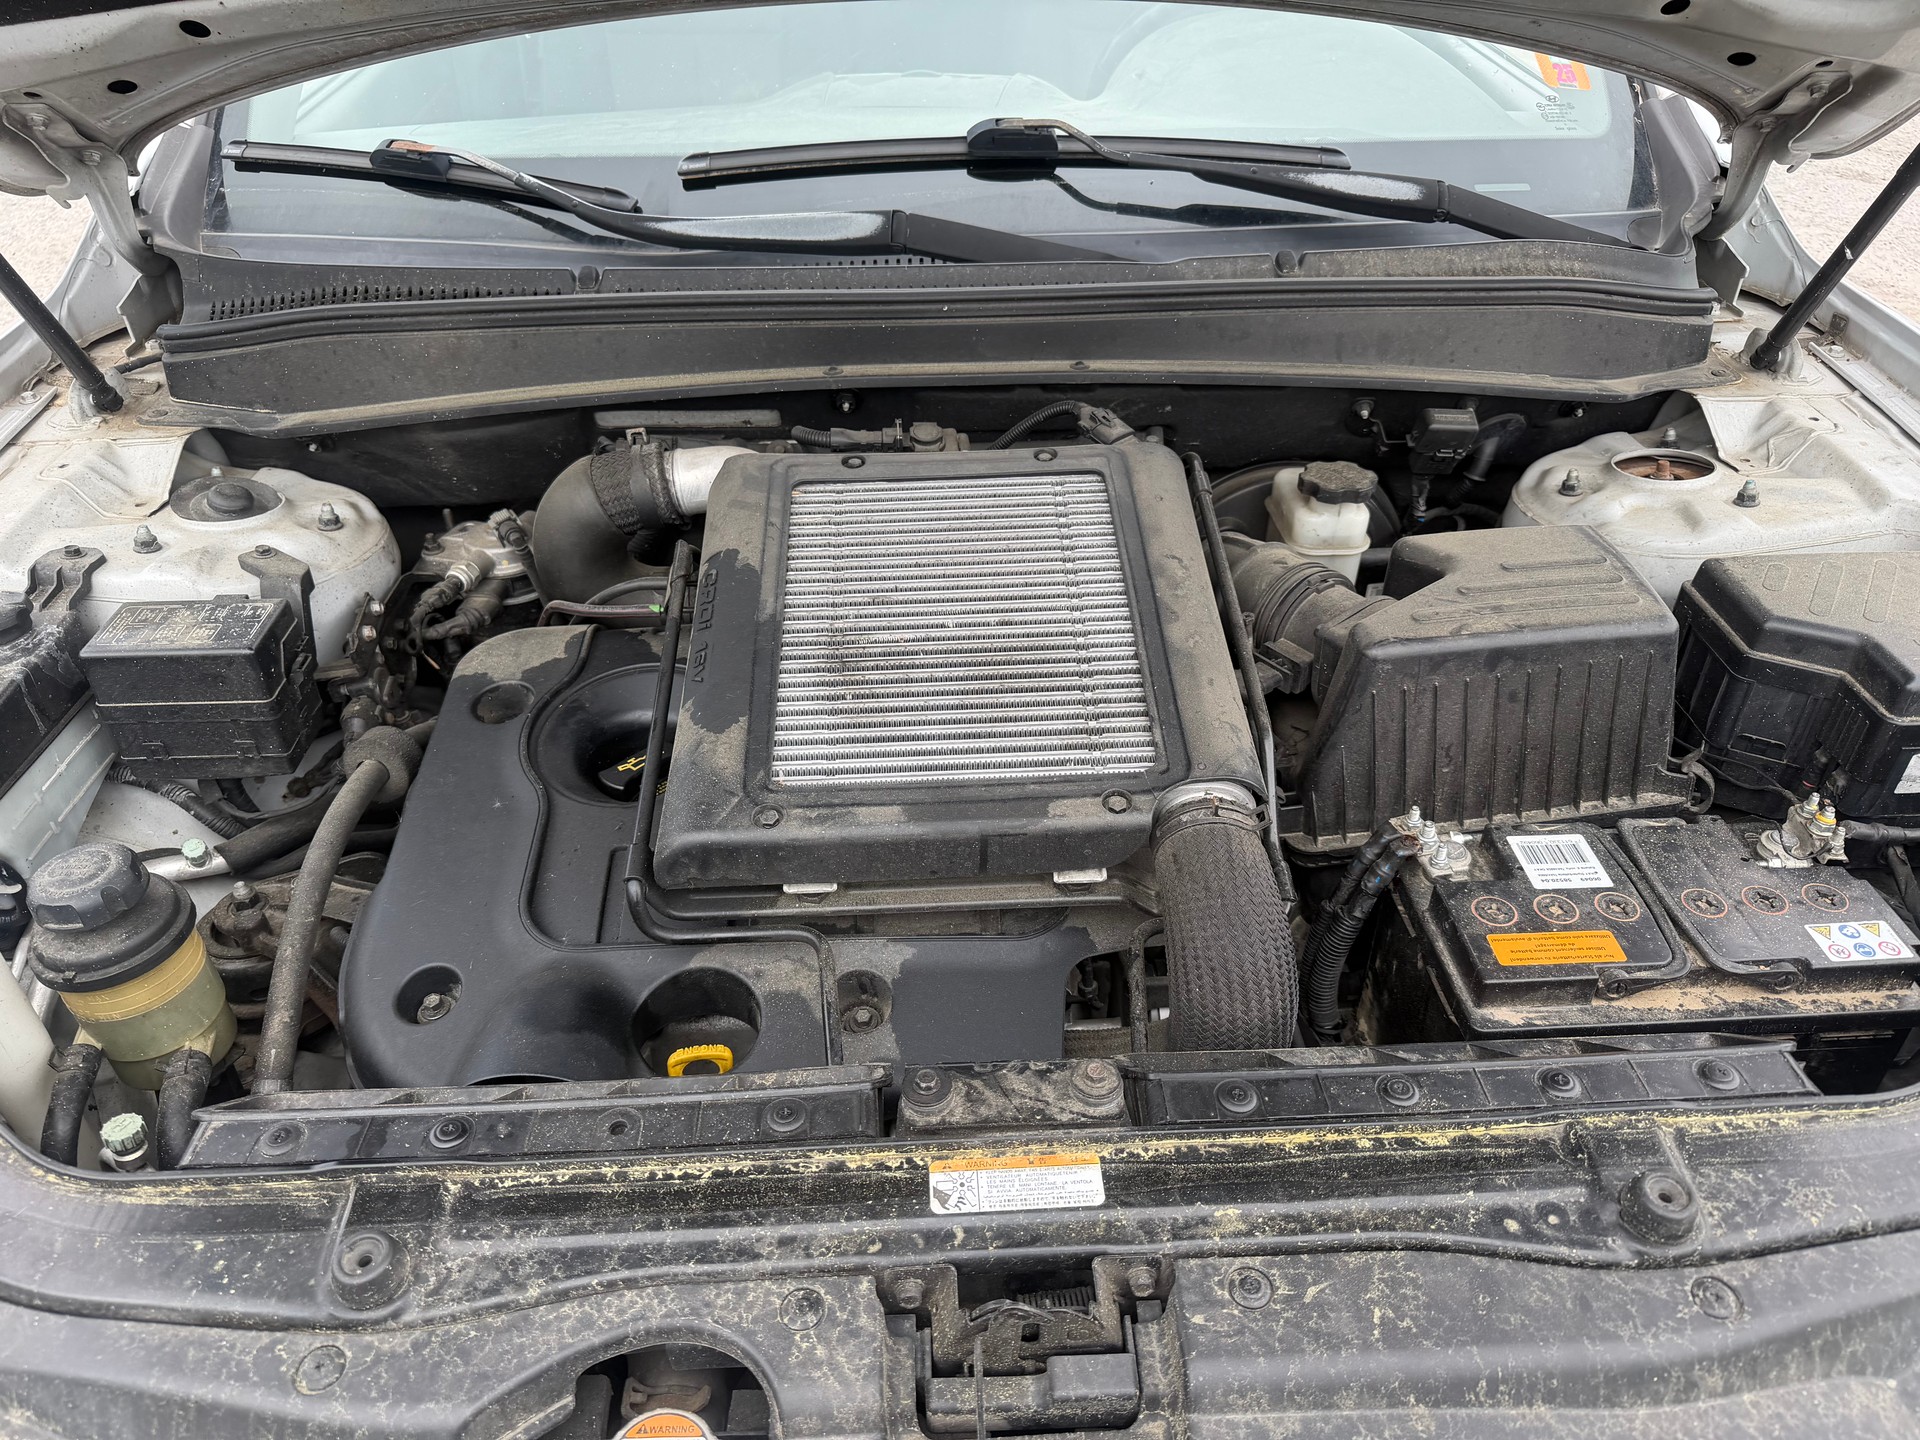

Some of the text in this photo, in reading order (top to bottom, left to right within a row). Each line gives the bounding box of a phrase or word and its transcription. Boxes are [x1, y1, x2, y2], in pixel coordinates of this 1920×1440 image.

[1552, 63, 1577, 83] 25
[690, 641, 710, 684] 16V
[676, 1044, 725, 1056] ENGINE
[649, 1425, 695, 1434] WARNING
